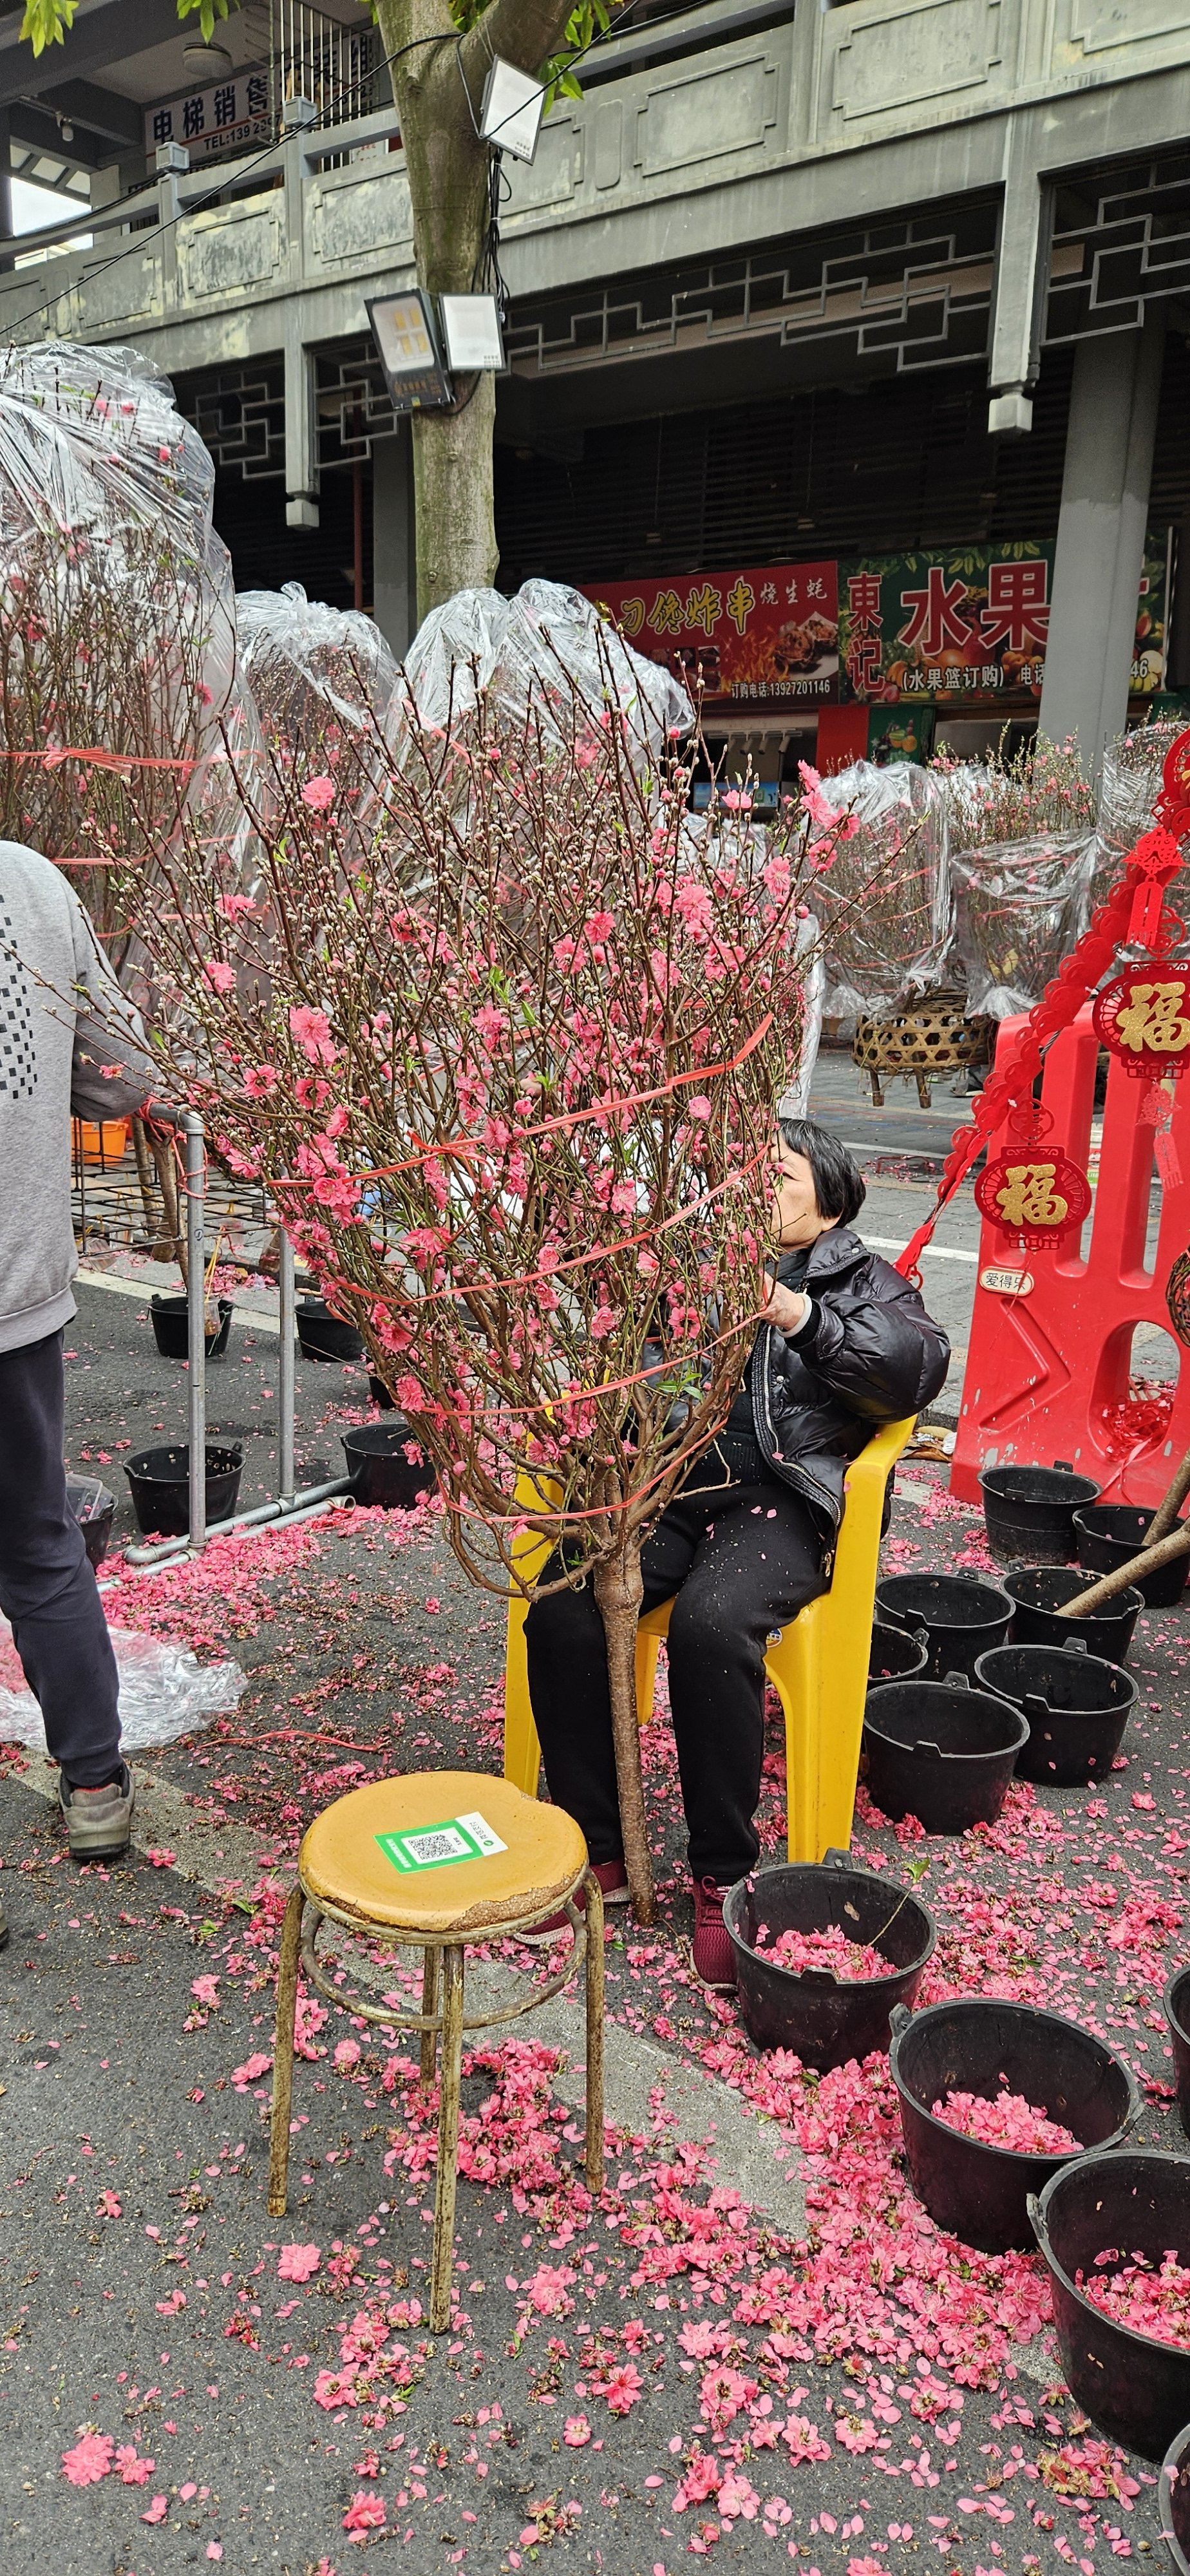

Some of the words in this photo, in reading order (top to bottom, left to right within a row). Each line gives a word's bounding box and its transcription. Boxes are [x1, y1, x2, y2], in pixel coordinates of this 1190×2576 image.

[760, 577, 827, 605] 烧生蚝
[900, 558, 1052, 658] 水果
[847, 571, 885, 693] 東记
[731, 679, 830, 699] 订购电话:13927201146
[903, 664, 1004, 692] (水果篮订购)
[1116, 981, 1190, 1052] 福
[996, 1163, 1068, 1226] 福
[985, 1272, 1026, 1291] 爱得乐
